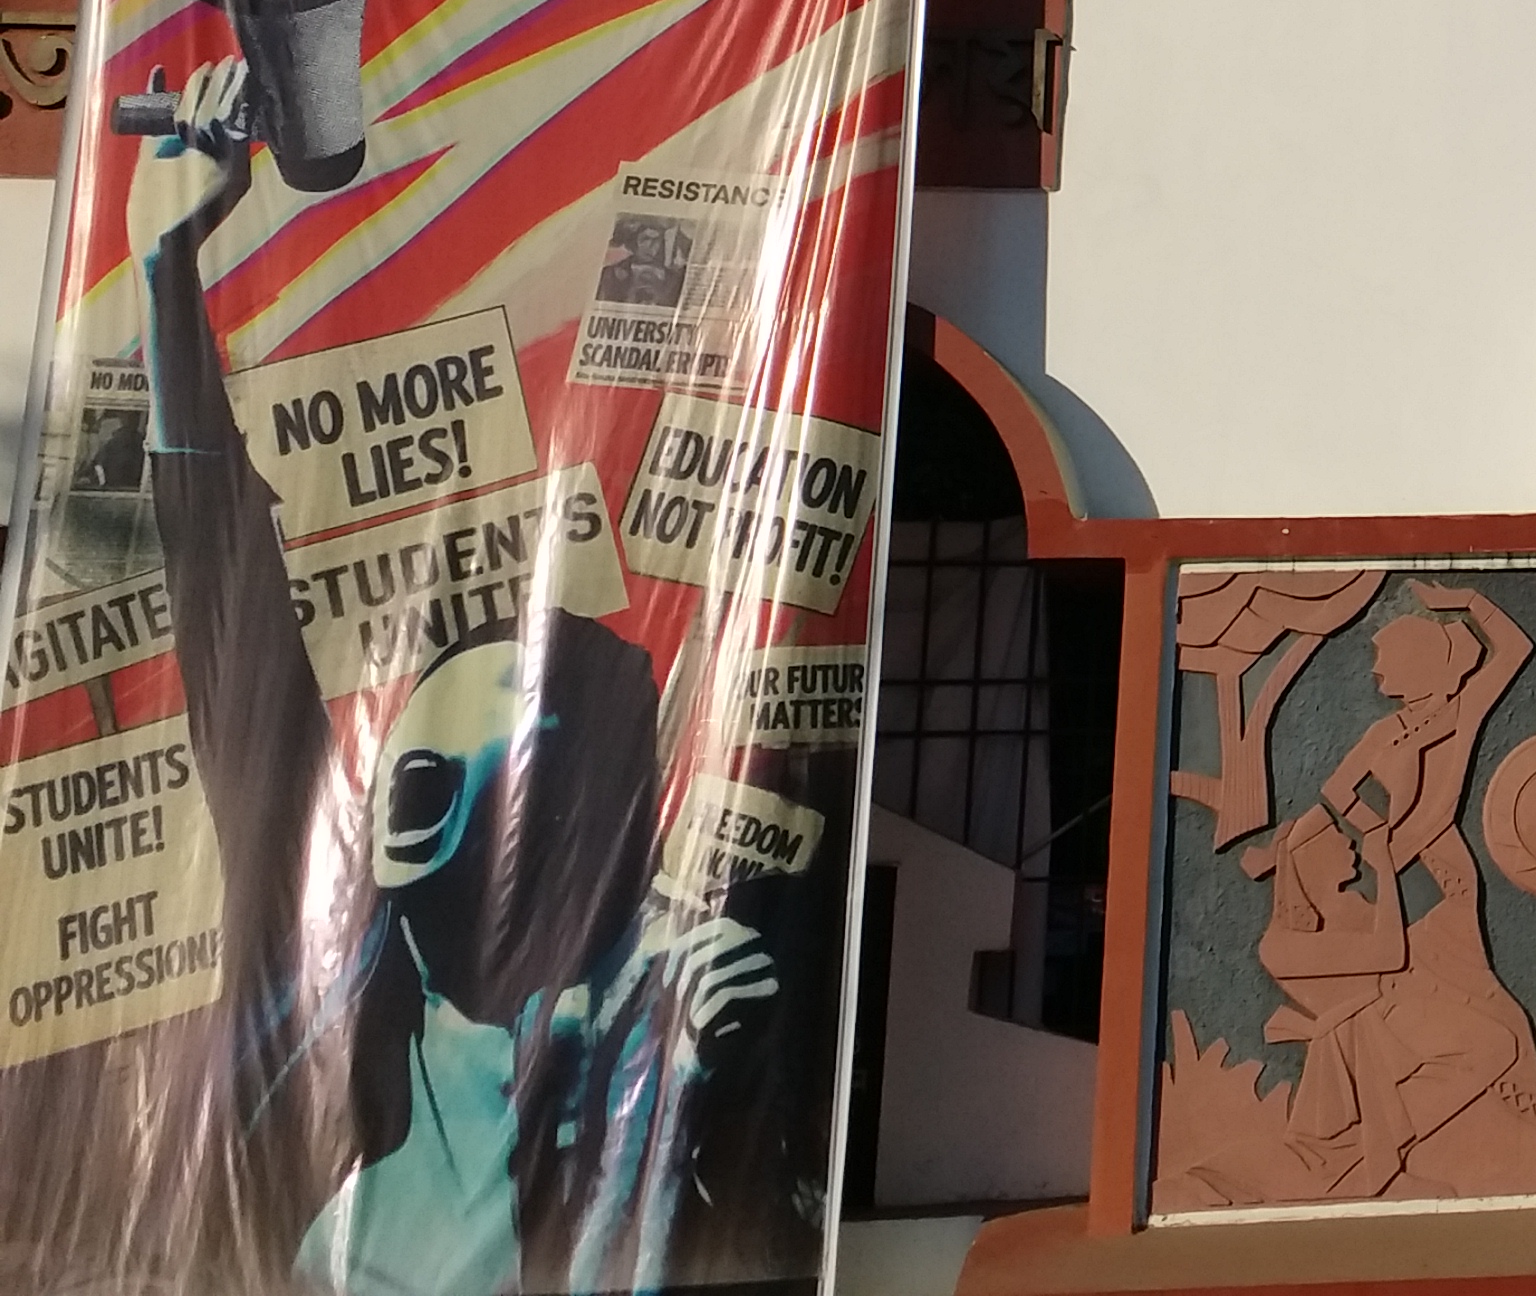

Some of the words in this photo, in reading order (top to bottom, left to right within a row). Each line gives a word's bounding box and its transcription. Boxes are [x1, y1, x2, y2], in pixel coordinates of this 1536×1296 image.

[622, 174, 787, 208] RESISTANC
[90, 371, 113, 390] NO
[579, 343, 661, 373] SCANDAL
[272, 390, 344, 456] NO
[356, 344, 503, 433] MORE
[341, 419, 472, 507] LIES!
[628, 489, 715, 549] NOT
[787, 663, 865, 694] FUTUR
[4, 743, 190, 834] STUDENTS
[41, 805, 166, 880] UNITE!
[58, 890, 159, 961] FIGHT
[9, 927, 223, 1028] OPPRESSION!
